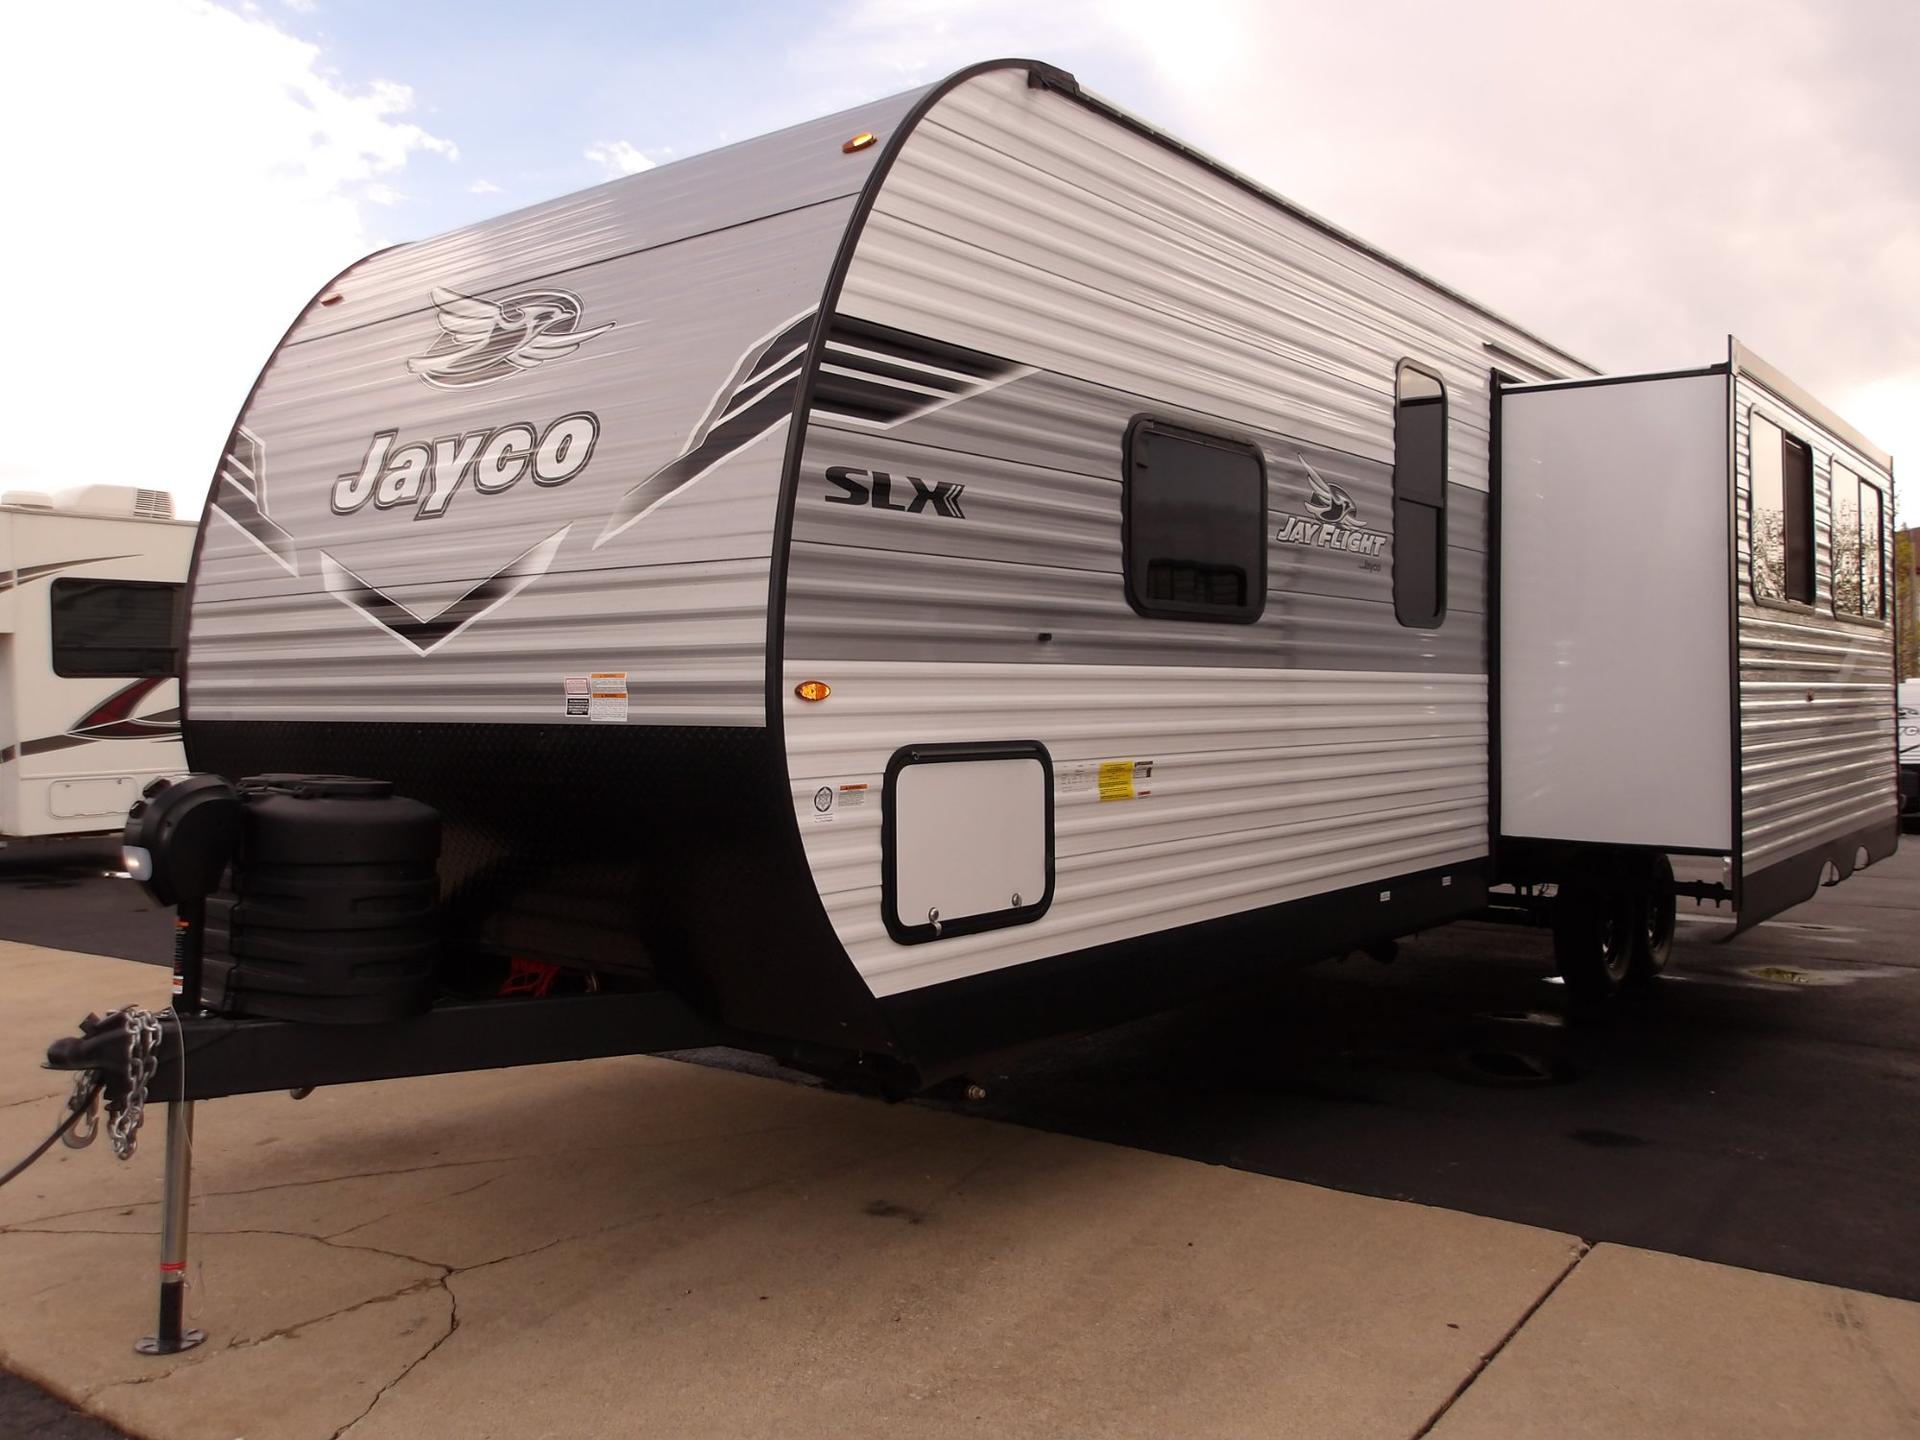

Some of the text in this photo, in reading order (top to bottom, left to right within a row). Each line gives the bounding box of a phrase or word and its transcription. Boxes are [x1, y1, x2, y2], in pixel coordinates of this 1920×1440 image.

[330, 411, 600, 521] Jayco
[825, 466, 966, 519] SLX
[1276, 515, 1388, 557] JAY FLIGHT
